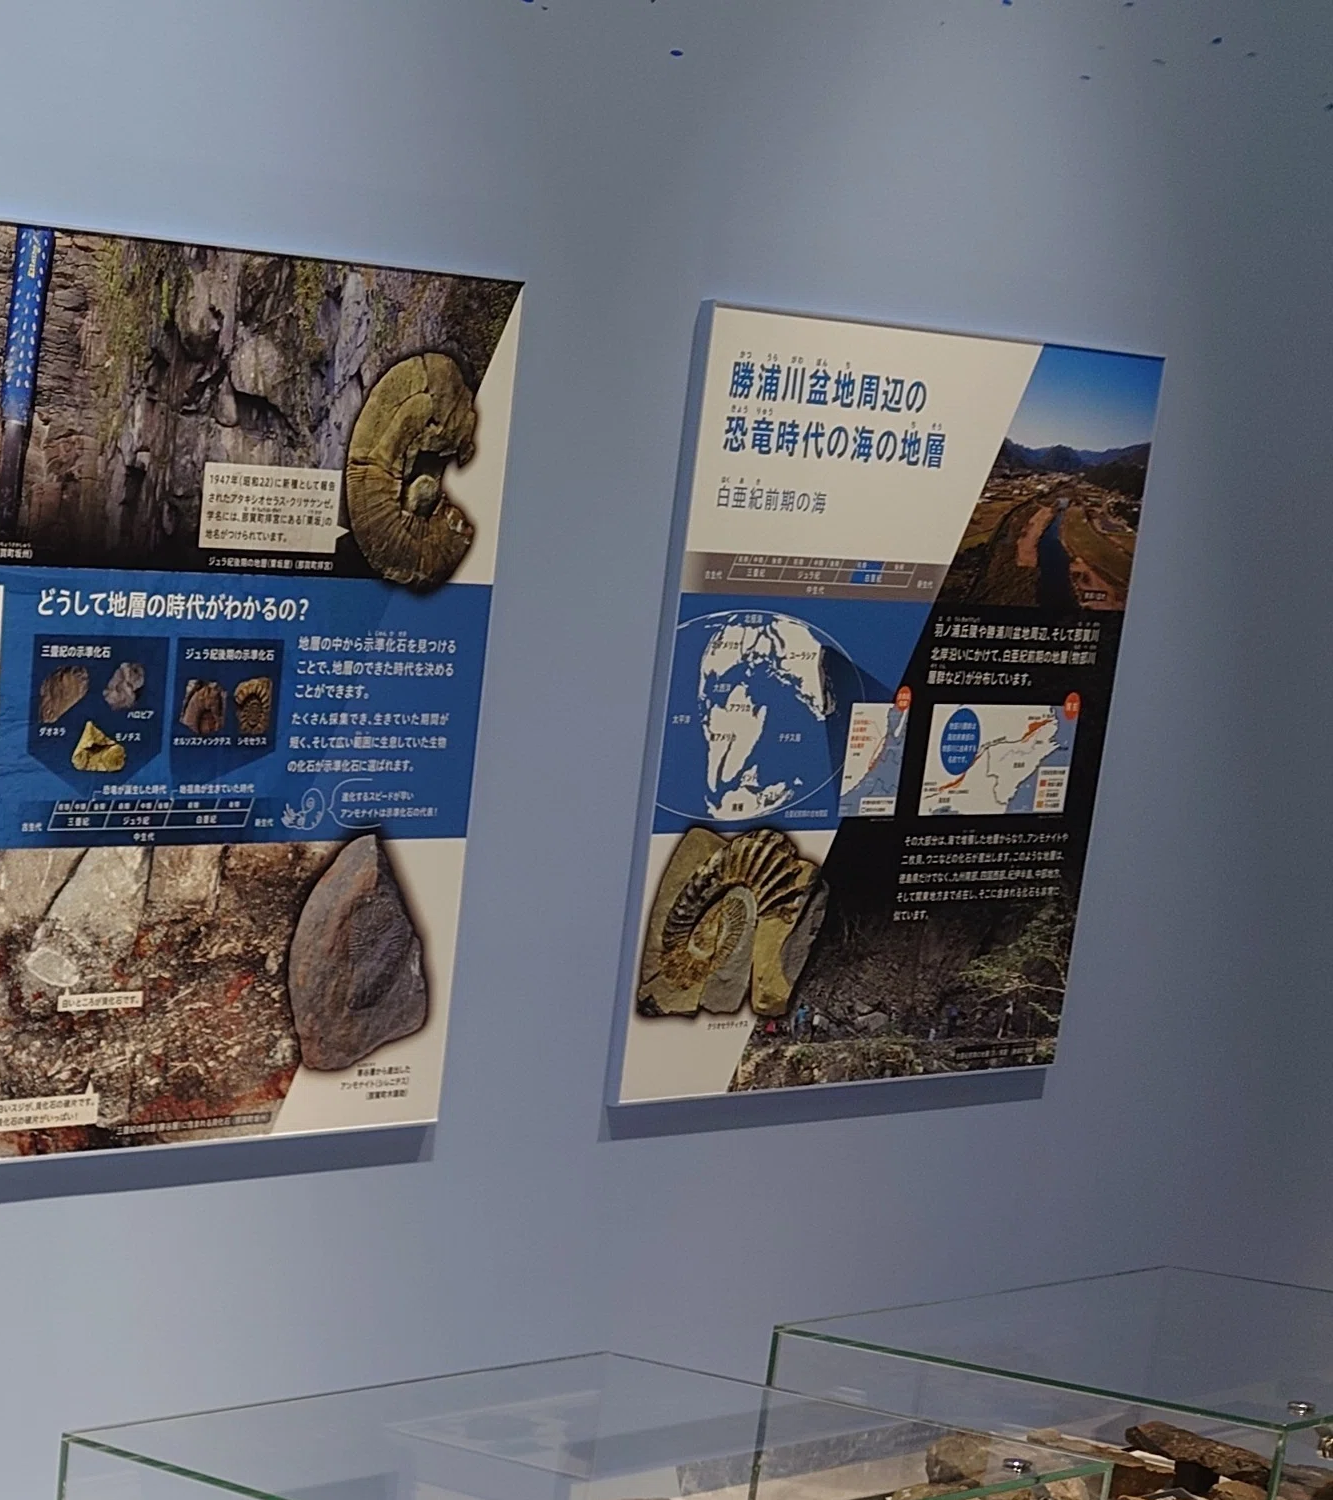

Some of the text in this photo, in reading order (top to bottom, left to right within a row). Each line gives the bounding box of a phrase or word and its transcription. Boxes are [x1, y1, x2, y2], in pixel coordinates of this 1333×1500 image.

[729, 361, 928, 413] 勝浦川盆地周辺の
[723, 415, 946, 469] 恐竜時代の海の地層
[716, 485, 827, 515] 白亜紀前期の海
[36, 588, 309, 622] どうして地層の時代がわかるの？
[298, 636, 457, 653] 地層の中から示準化石を見つける
[296, 661, 454, 677] ことで、地層のできた時代を決める
[294, 684, 370, 700] ことができます。
